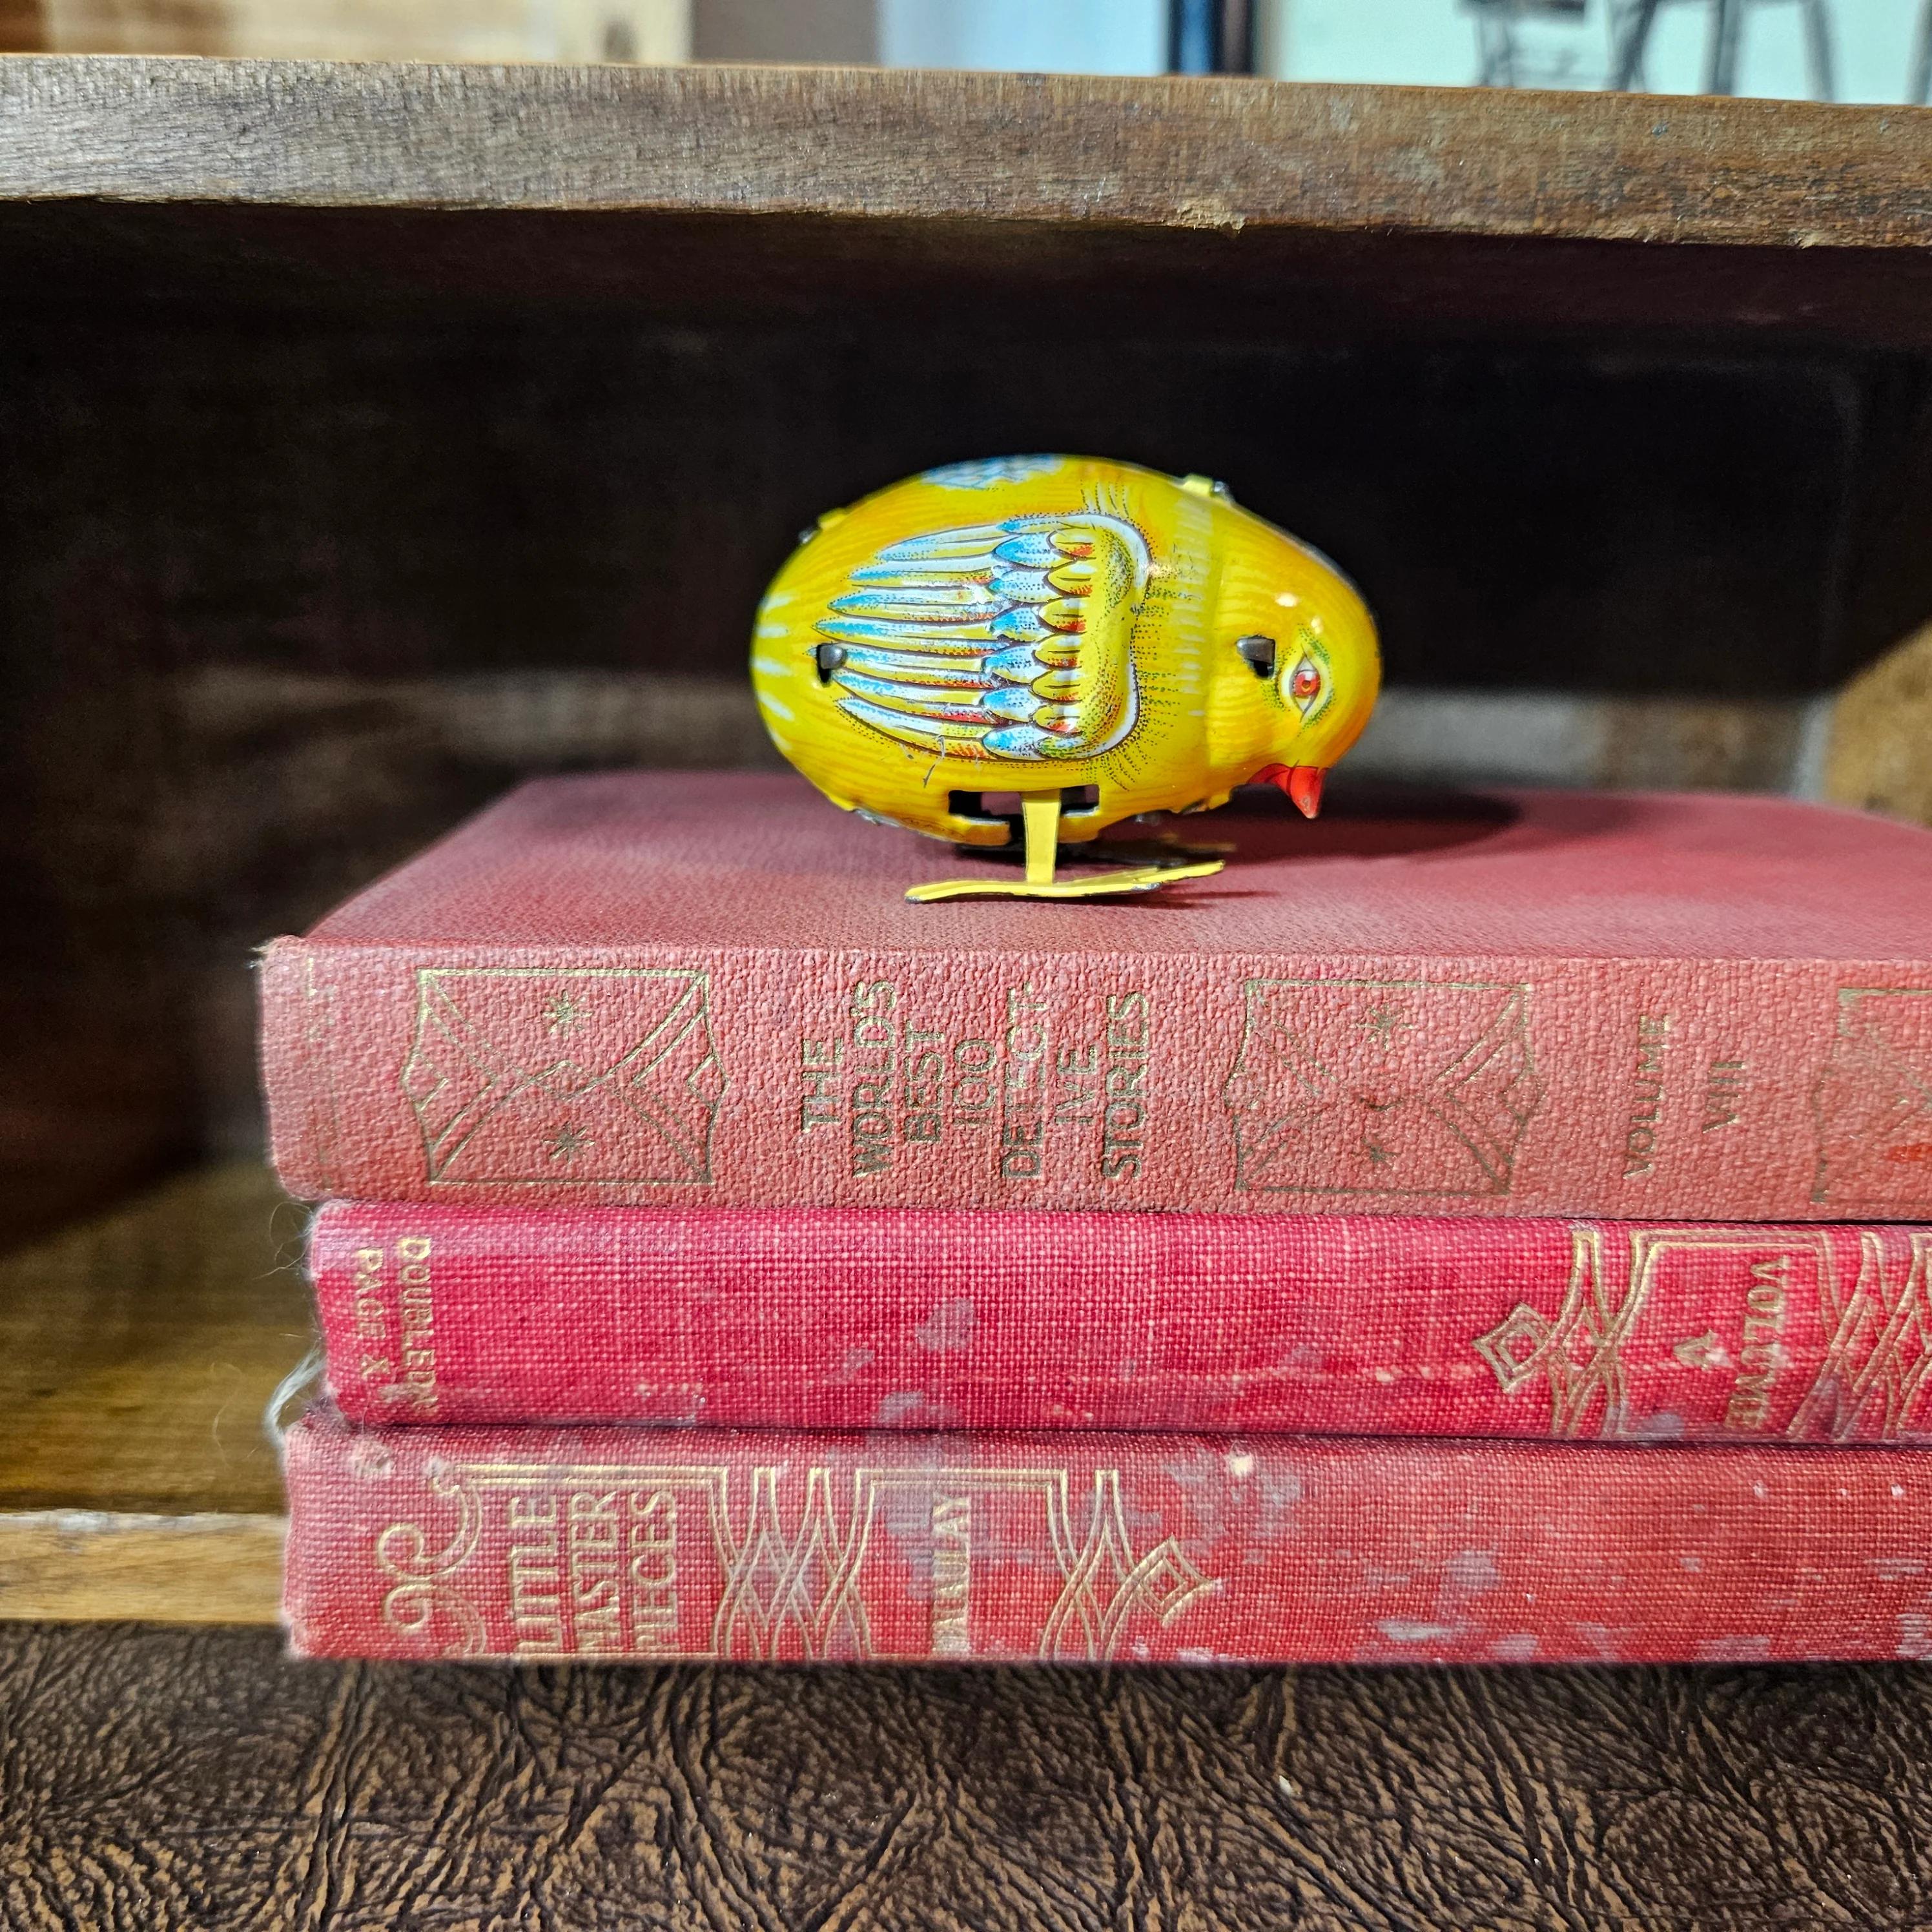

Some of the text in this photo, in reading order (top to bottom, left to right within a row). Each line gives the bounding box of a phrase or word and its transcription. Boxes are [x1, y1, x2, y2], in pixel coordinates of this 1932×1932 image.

[801, 1037, 843, 1134] THE
[852, 980, 897, 1178] WORLD'S
[904, 1019, 945, 1144] BEST
[953, 1038, 997, 1127] 100
[1001, 981, 1048, 1179] DETECT-
[1053, 1043, 1099, 1125] IVE
[1102, 991, 1151, 1180] STORIES
[1622, 1015, 1671, 1179] VOLUME
[1701, 1060, 1746, 1135] VIII
[1723, 1255, 1790, 1430] VOLUME
[511, 1494, 561, 1652] LITTLE
[570, 1490, 621, 1652] MASTER
[628, 1490, 679, 1652] PIECES
